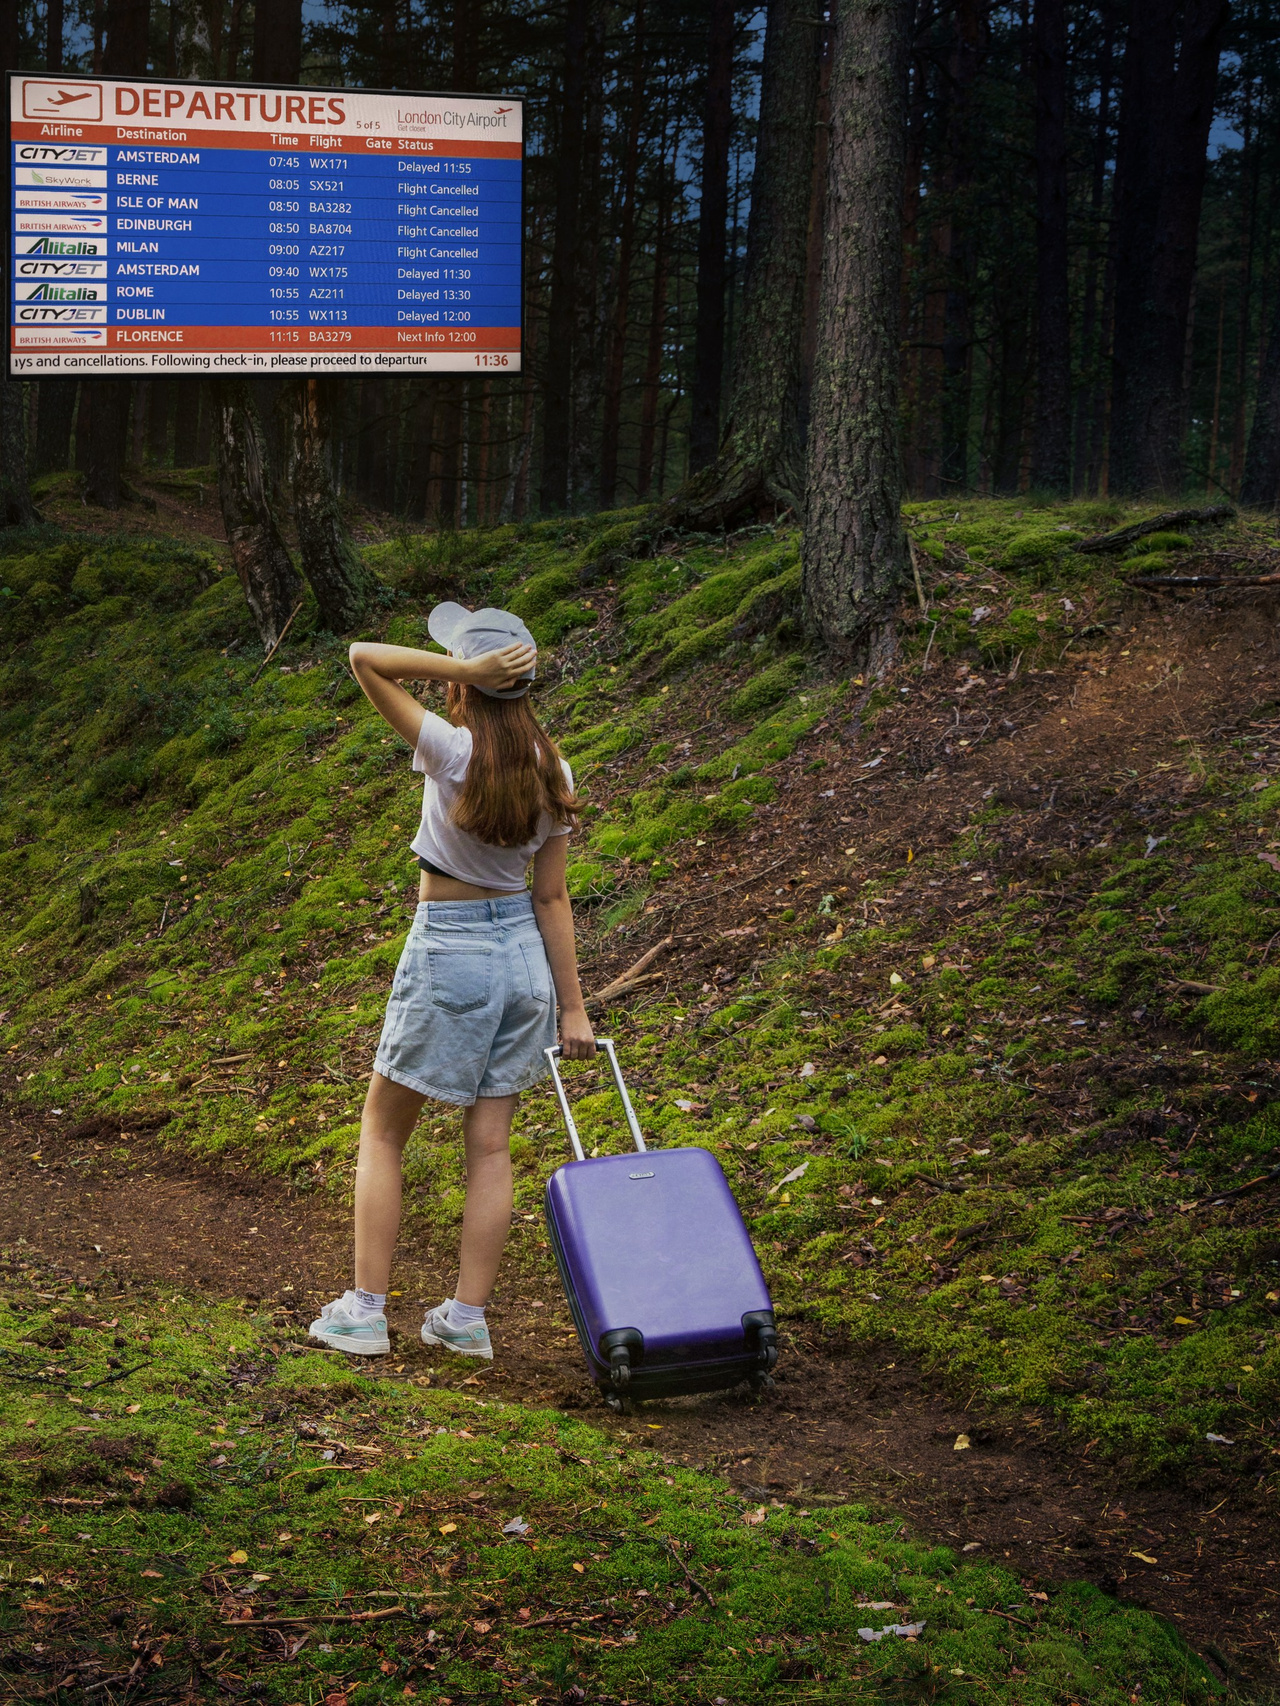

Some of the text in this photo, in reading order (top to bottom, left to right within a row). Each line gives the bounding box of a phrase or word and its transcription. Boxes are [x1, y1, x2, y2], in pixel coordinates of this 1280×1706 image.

[115, 87, 346, 125] DEPARTURES
[363, 121, 373, 129] of
[398, 110, 507, 129] London City Airport
[397, 124, 408, 132] Get
[41, 124, 434, 151] Airline Destination Time Flight Gate Status
[20, 147, 102, 162] CITYJET
[117, 151, 471, 173] AMSTERDAM 07:45 WX171 Delayed 11:55
[45, 176, 91, 186] SkyWork
[117, 174, 478, 195] BERNE 08:05 SX521 Flight Cancelled
[53, 200, 87, 208] AIRWAYS
[117, 197, 478, 216] ISLE OF MAN 08:50 BA3282 Flight Cancelled
[53, 223, 87, 231] AIRWAYS
[117, 219, 478, 237] EDINBURGH 08:50 BA8704 Flight Cancelled
[26, 237, 98, 255] Alitalia
[117, 242, 478, 259] MILAN 09:00 AZ217 Flight Cancelled
[20, 263, 102, 276] CITYJET
[117, 264, 470, 280] AMSTERDAM 09:40 WX175 Delayed 11:30
[26, 283, 98, 300] Alitalia
[117, 287, 470, 301] ROME 10:55 AZ211 Delayed 13:30
[20, 308, 102, 321] CITYJET
[117, 309, 470, 322] DUBLIN 10:55 WX113 Delayed 12:00
[20, 336, 51, 344] BRITISH
[117, 331, 476, 342] FLORENCE 11:15 BA3279 Next Info 12:00
[15, 358, 33, 370] ys
[36, 354, 60, 367] and
[64, 354, 148, 367] cancellations.
[151, 354, 211, 369] Following
[214, 353, 268, 368] check-in,
[270, 354, 308, 368] please
[310, 354, 357, 368] proceed
[360, 355, 372, 365] to
[474, 354, 509, 367] 11:36
